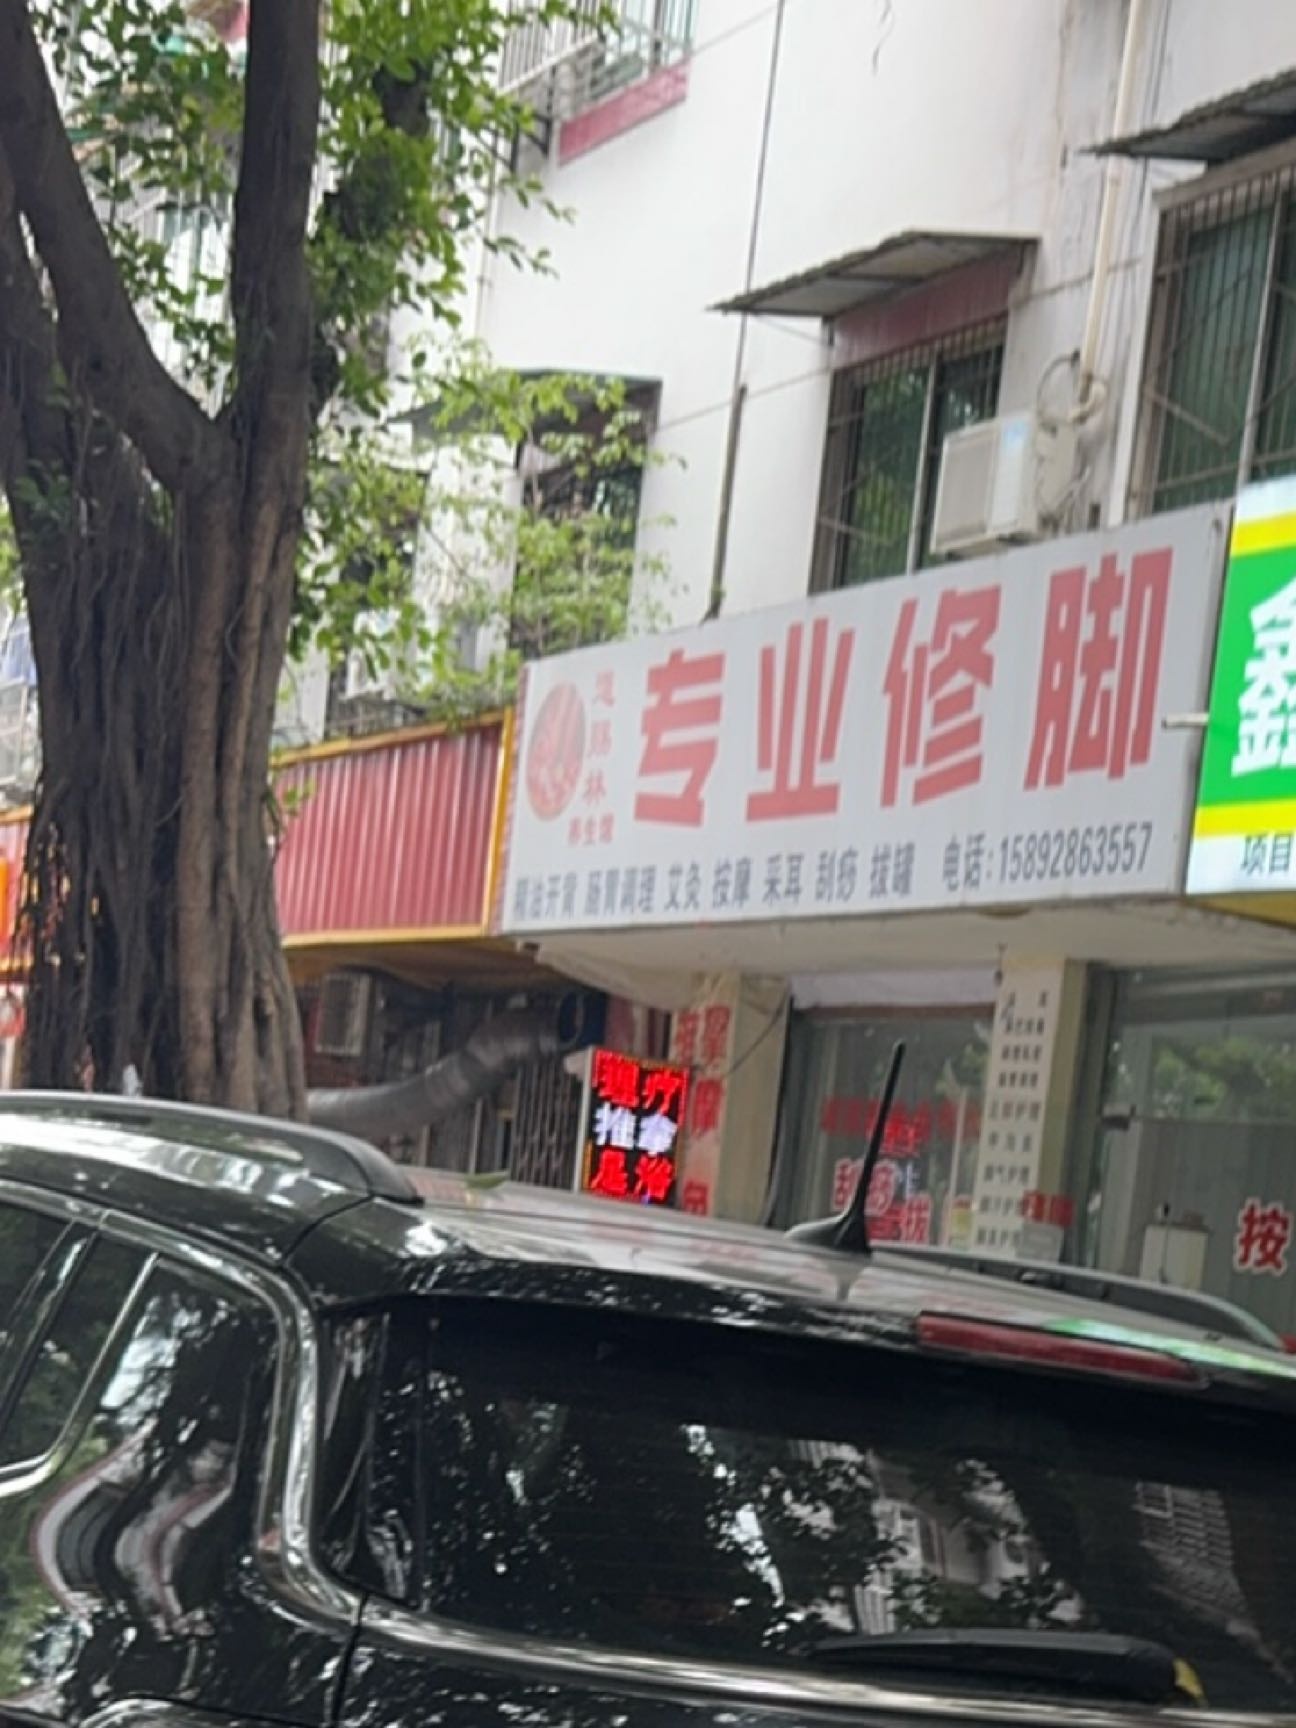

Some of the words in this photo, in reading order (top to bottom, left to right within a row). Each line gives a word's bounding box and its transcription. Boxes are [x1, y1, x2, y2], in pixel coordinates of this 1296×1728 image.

[633, 546, 1175, 827] 专业修脚
[711, 855, 754, 909] 按摩
[762, 850, 805, 906] 采耳
[1234, 1197, 1294, 1276] 按
